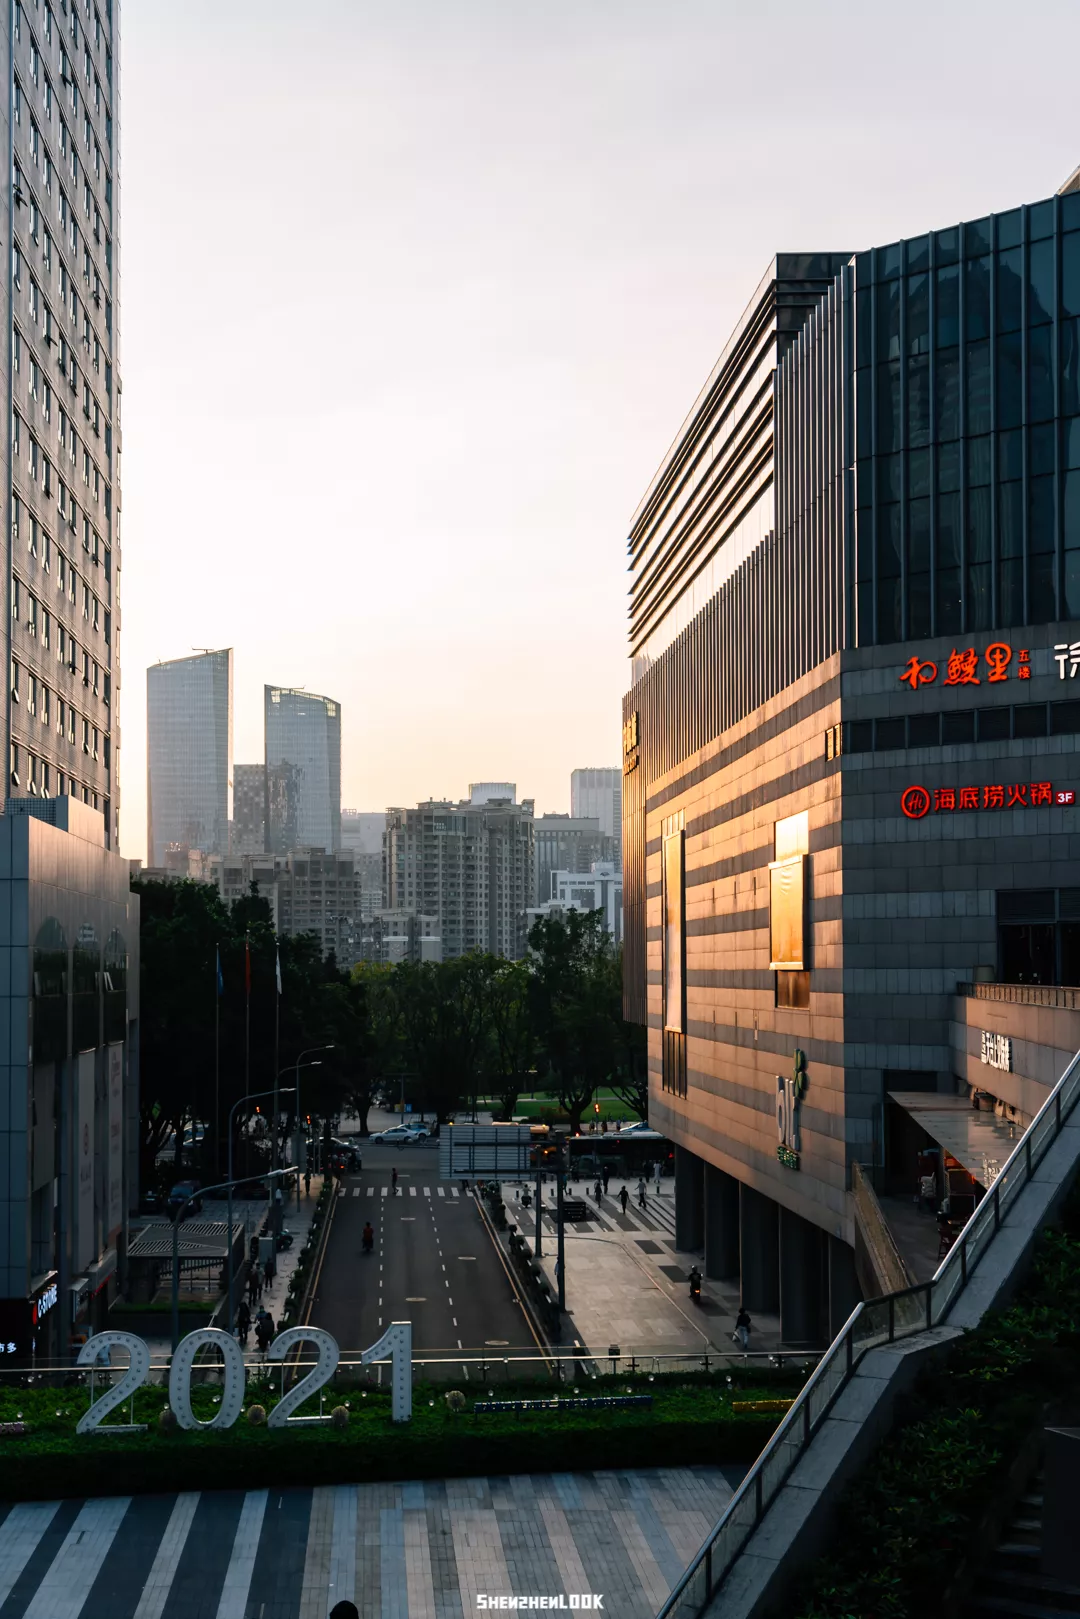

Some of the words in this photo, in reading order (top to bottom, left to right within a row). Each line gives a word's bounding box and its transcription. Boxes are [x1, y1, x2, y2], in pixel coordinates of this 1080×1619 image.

[1017, 649, 1031, 680] 五楼
[933, 781, 1052, 811] 海底捞火锅
[1057, 792, 1073, 803] 3F
[76, 1321, 413, 1434] 2021
